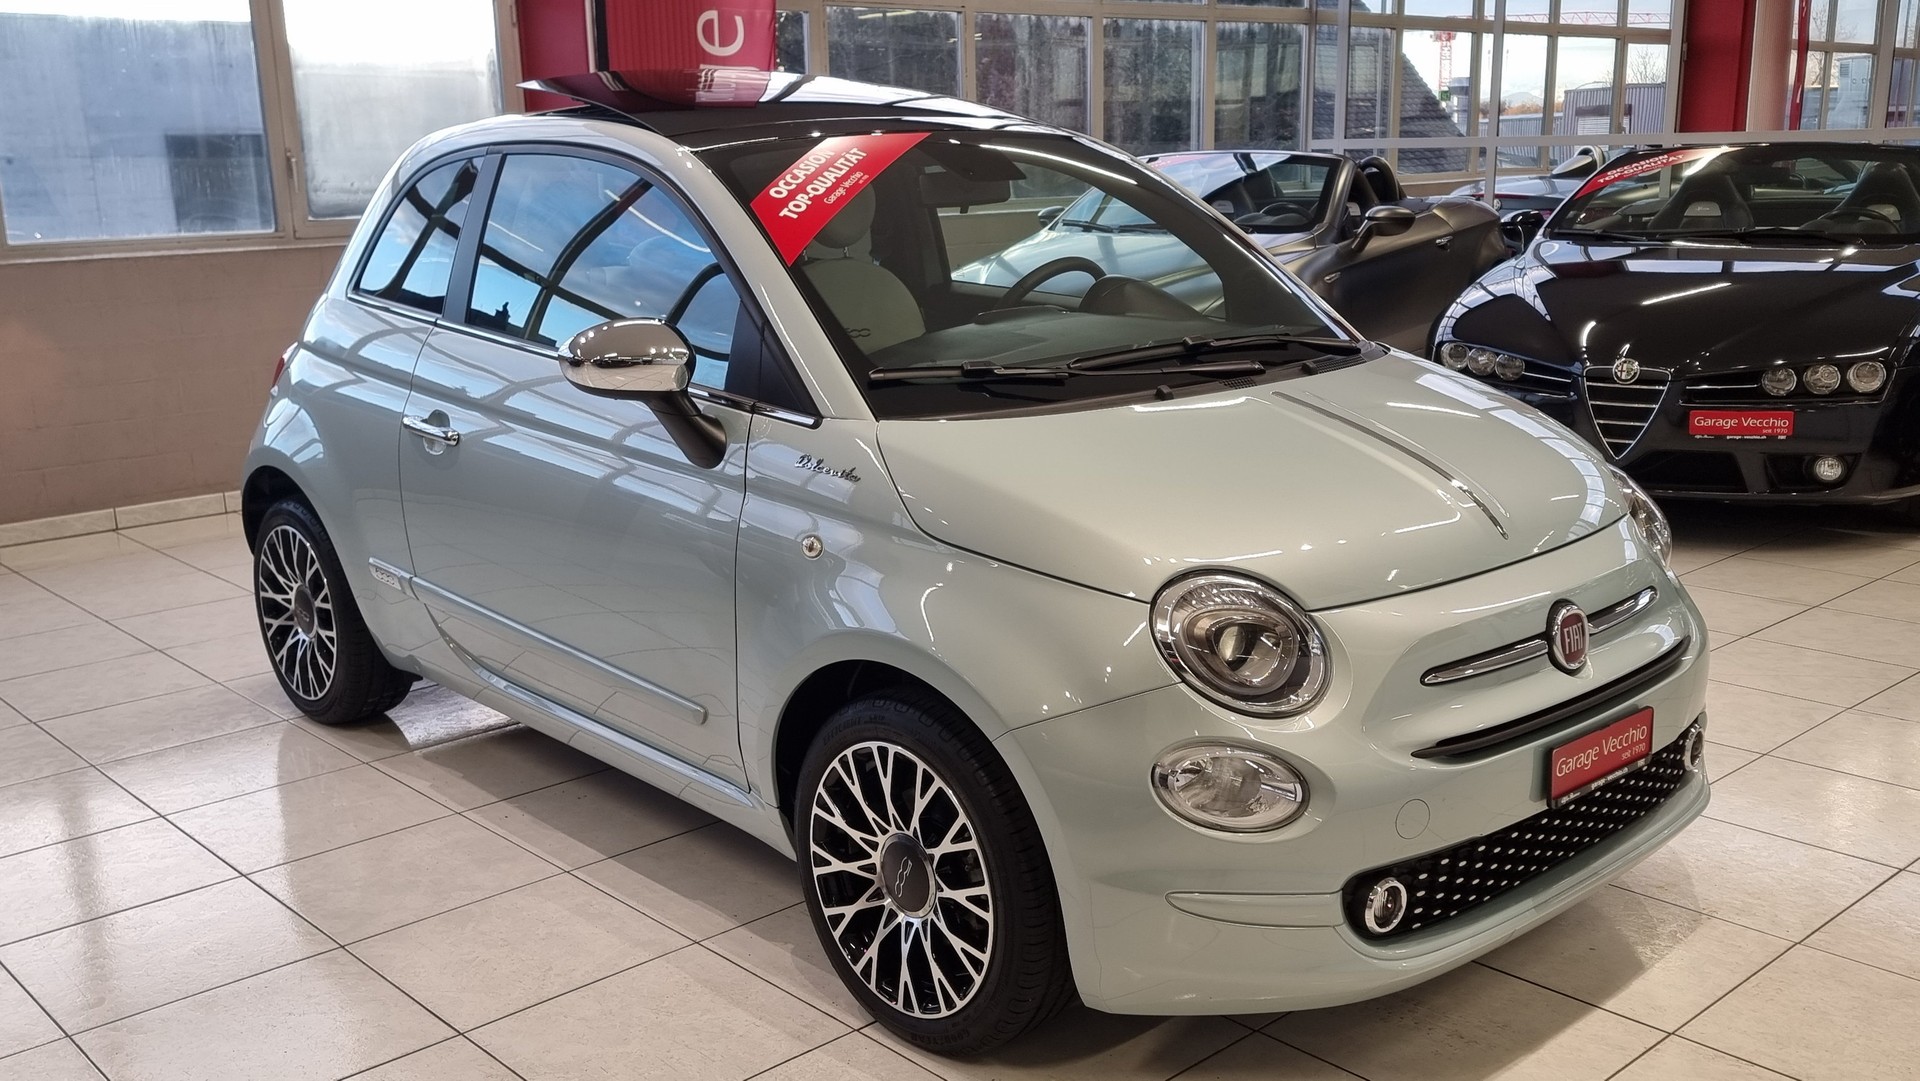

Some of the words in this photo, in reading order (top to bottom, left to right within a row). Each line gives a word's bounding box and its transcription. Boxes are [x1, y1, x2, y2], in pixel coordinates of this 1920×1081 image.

[769, 150, 835, 199] OCCASION
[1607, 154, 1669, 176] OCCASION
[779, 147, 867, 220] TOP-QUALITÄT
[823, 186, 846, 205] Garage
[1694, 416, 1739, 429] Garage
[1741, 416, 1789, 428] Vecchio
[1563, 622, 1583, 655] FIAT
[1556, 746, 1600, 777] Garage
[1602, 724, 1648, 756] Vecchio
[1621, 749, 1632, 761] seit
[1632, 742, 1646, 756] 1970
